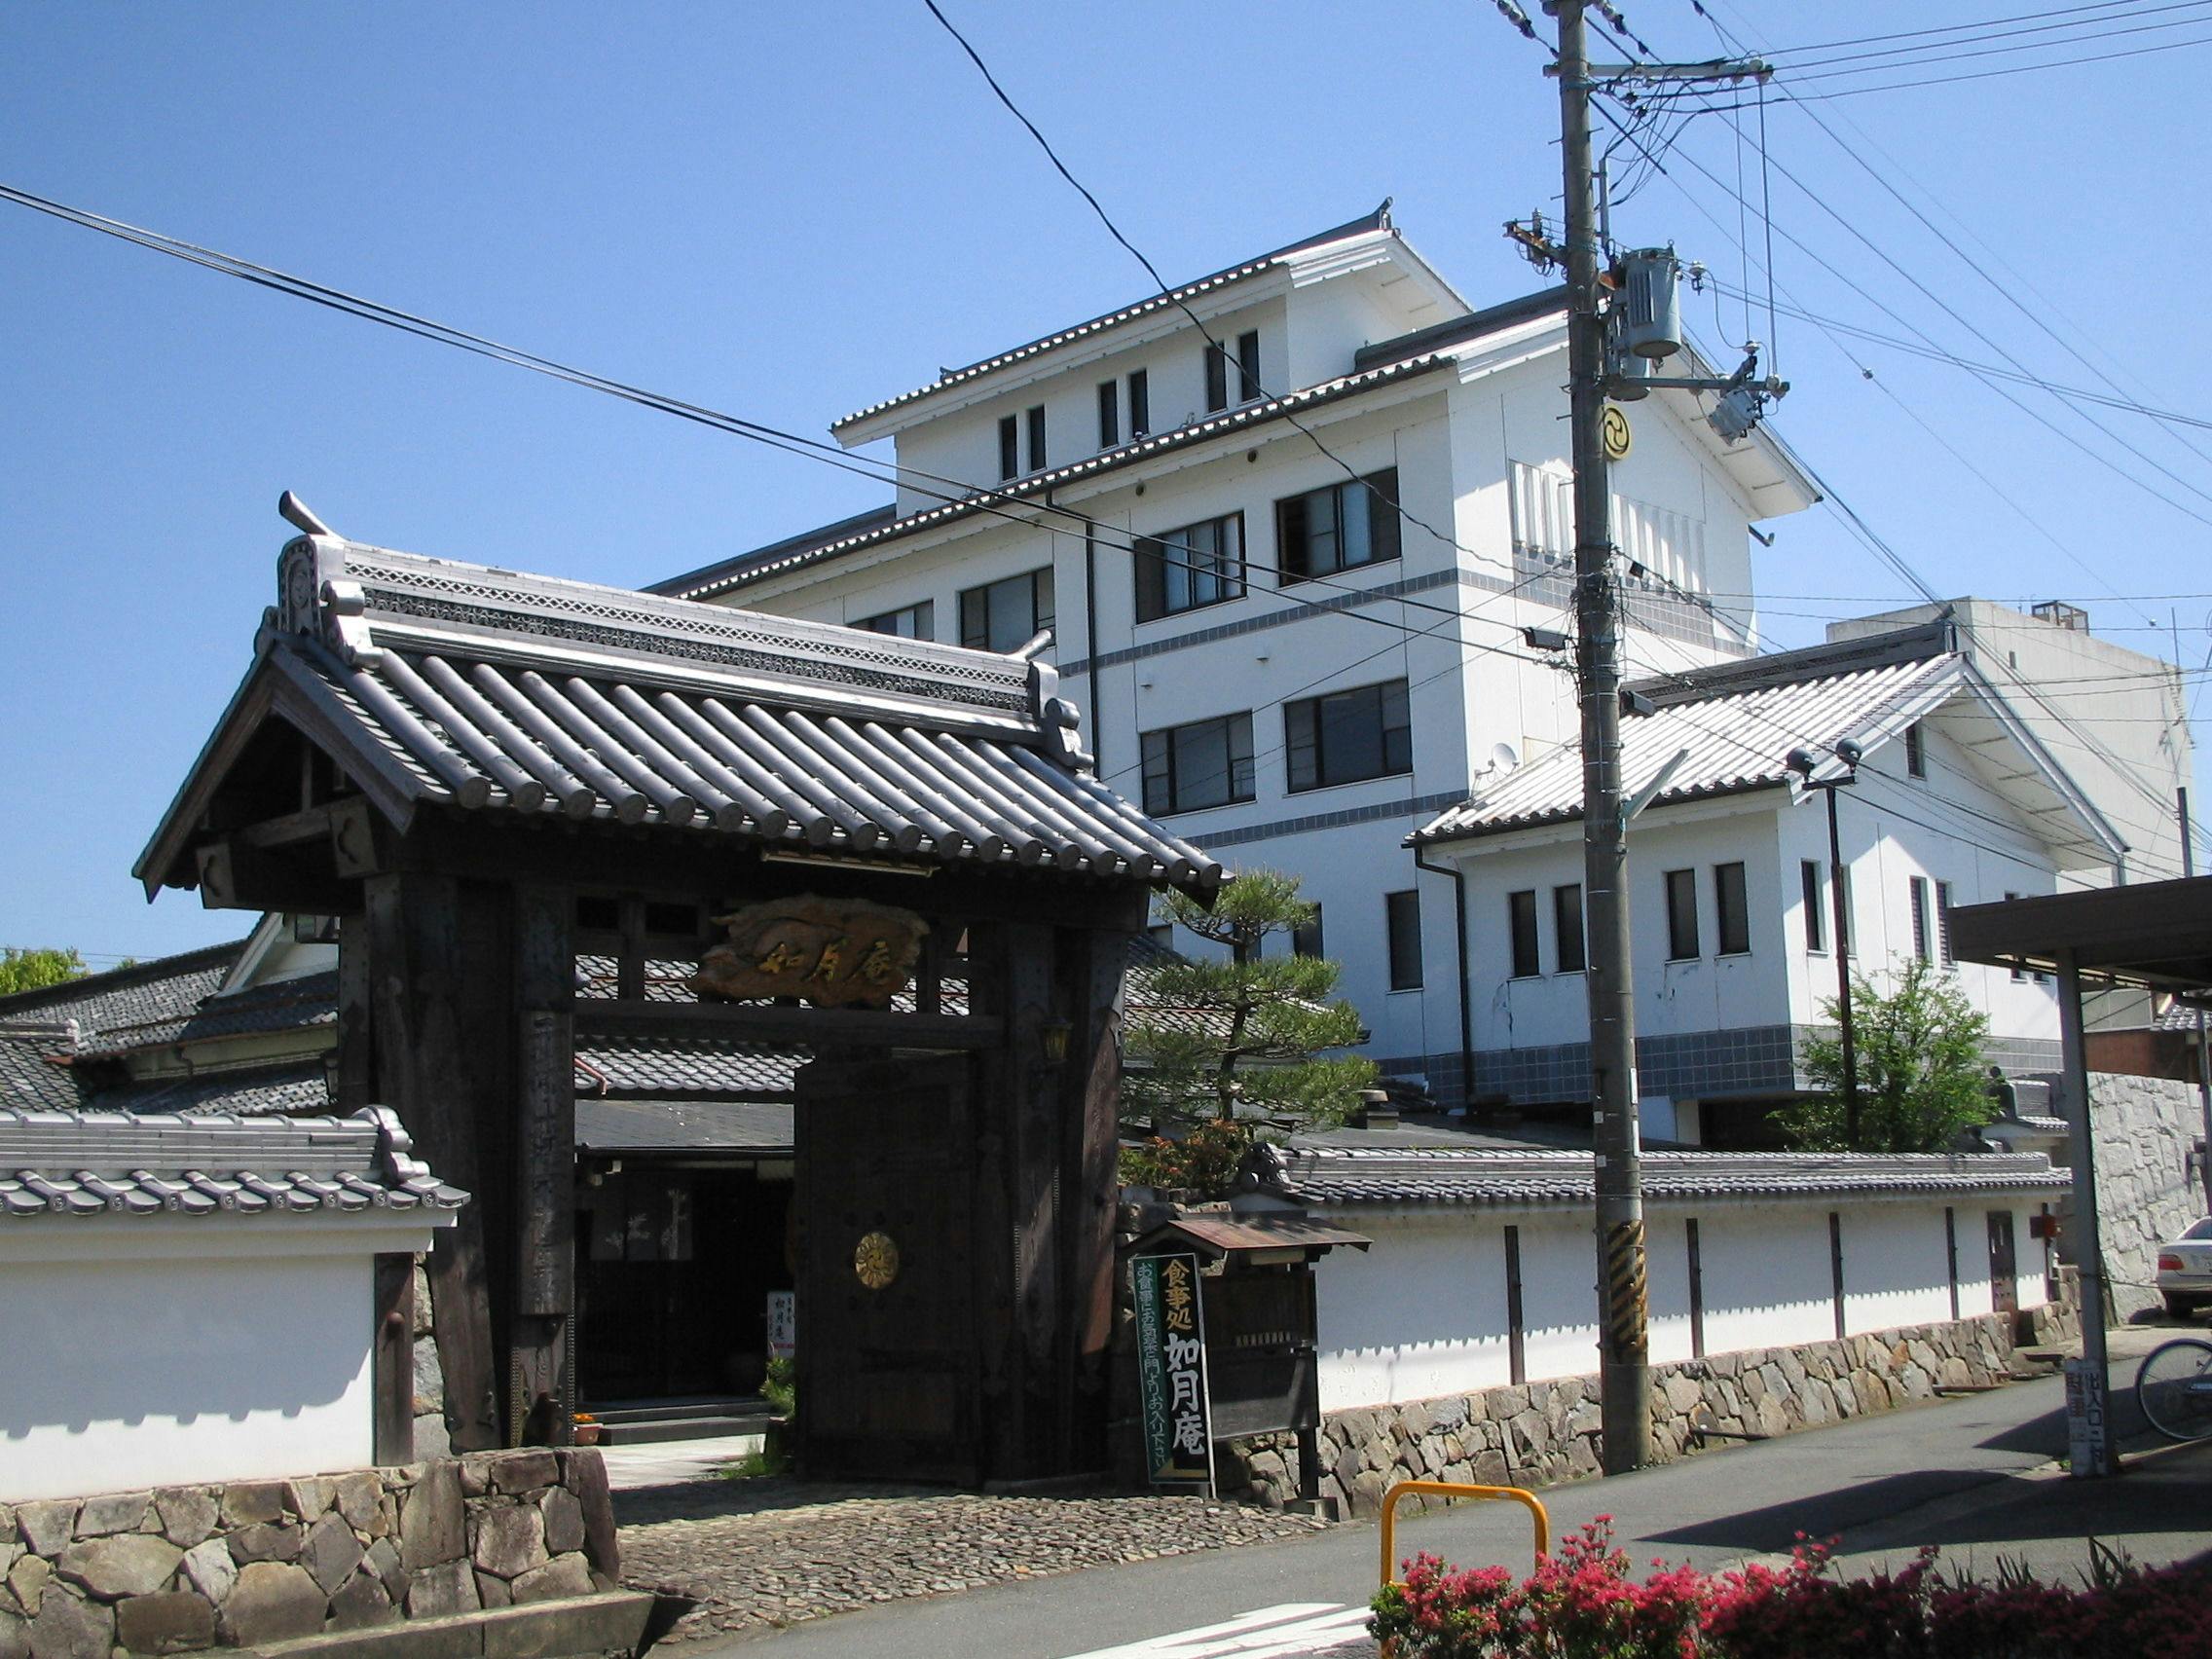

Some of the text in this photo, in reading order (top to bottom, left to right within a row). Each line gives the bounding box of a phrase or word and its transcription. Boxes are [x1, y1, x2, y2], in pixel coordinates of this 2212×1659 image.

[1162, 1259, 1192, 1331] 食事処
[1163, 1333, 1205, 1456] 如月庵
